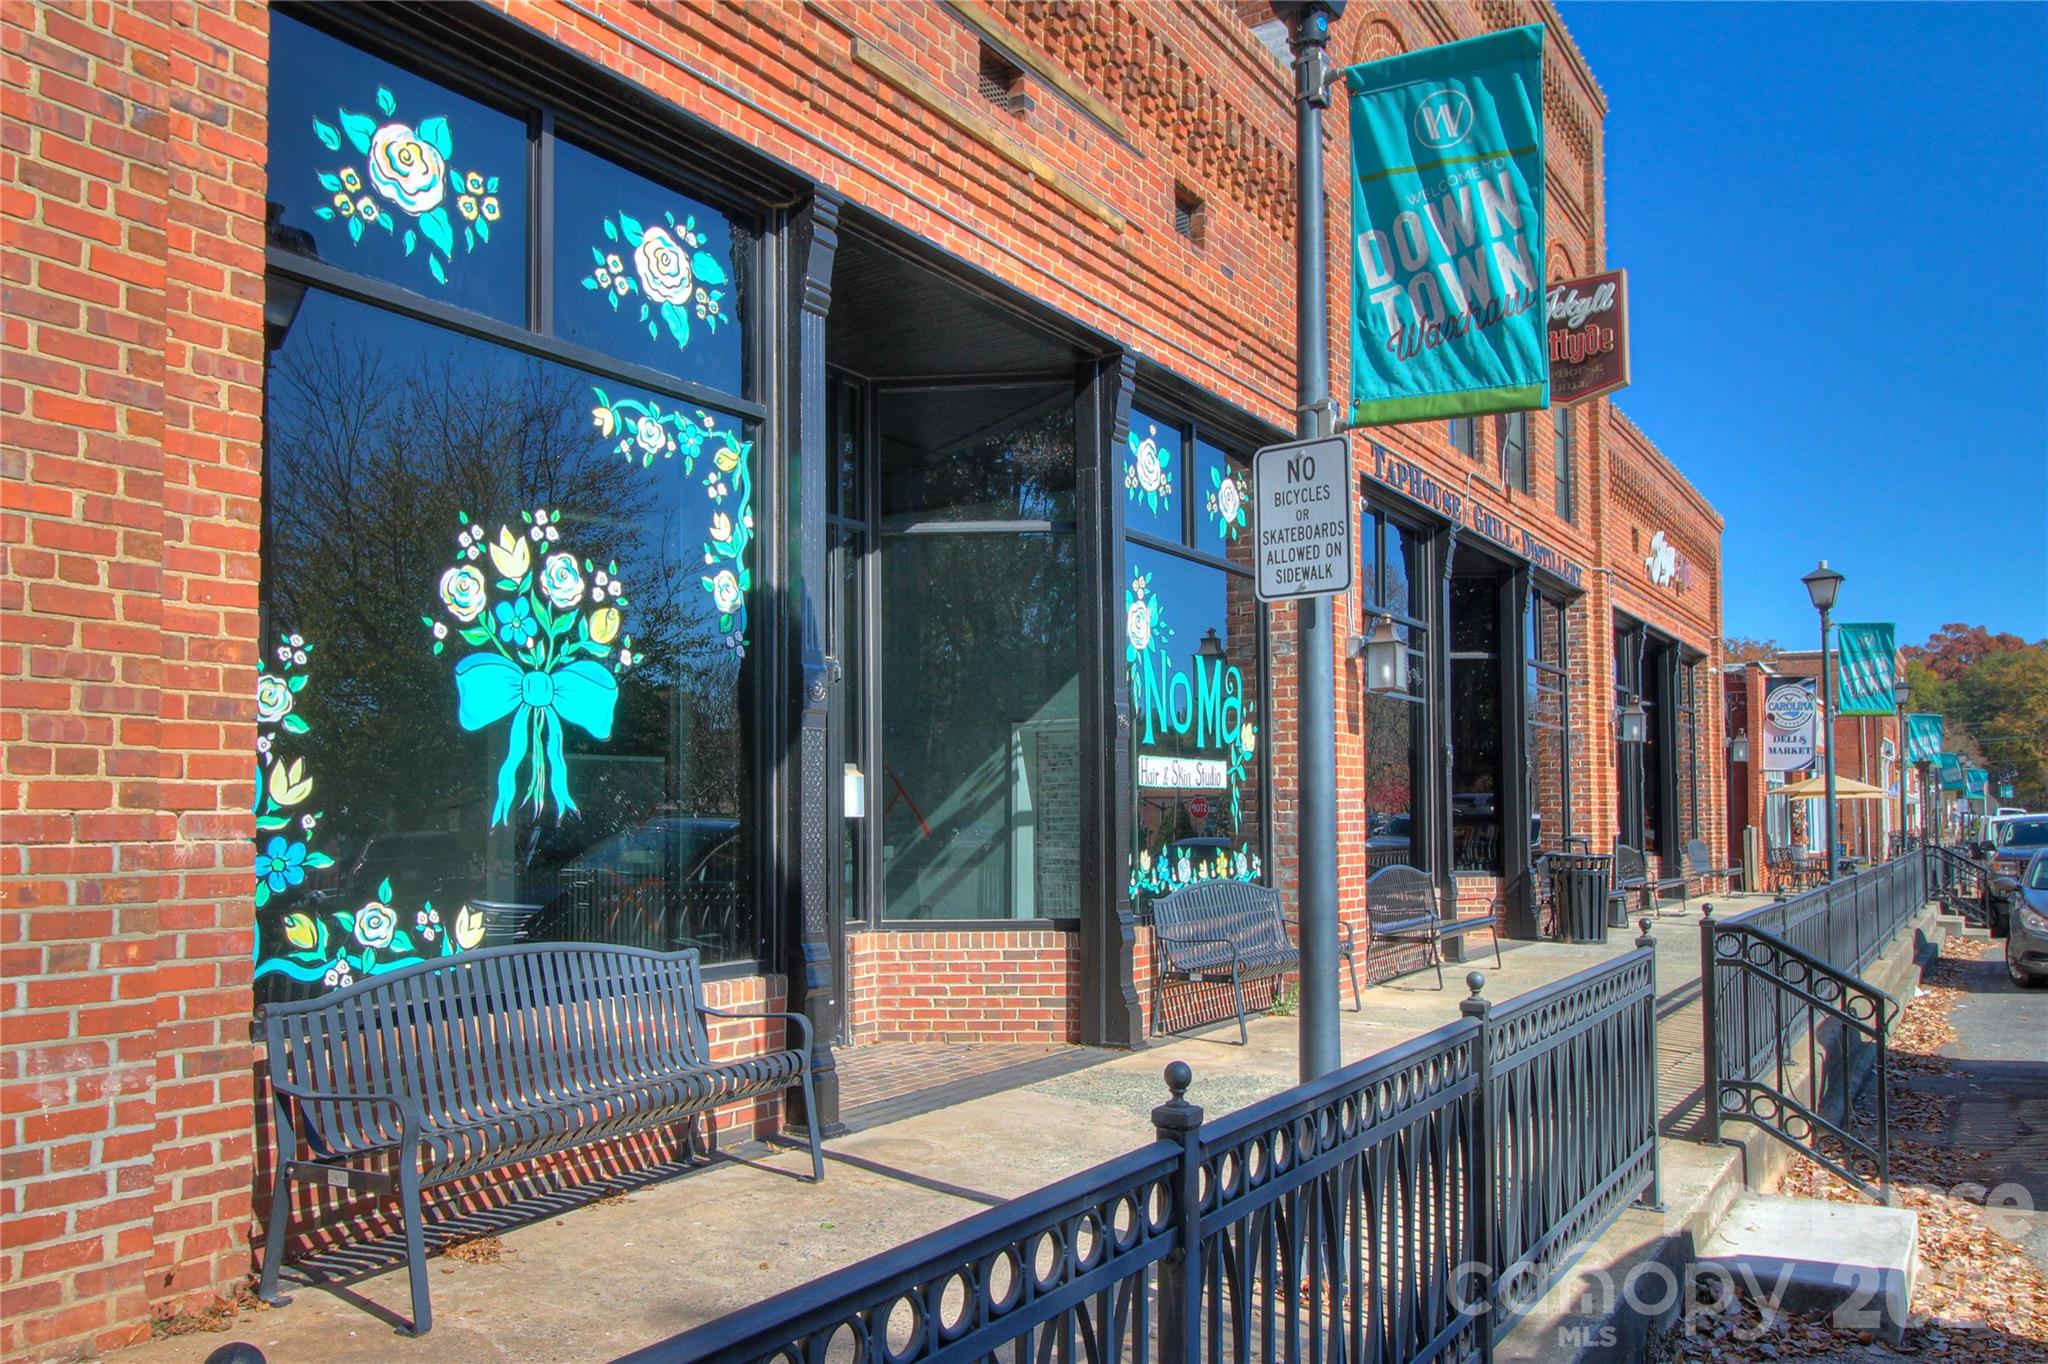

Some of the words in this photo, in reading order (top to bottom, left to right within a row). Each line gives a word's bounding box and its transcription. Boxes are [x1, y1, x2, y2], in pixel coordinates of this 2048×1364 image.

[1405, 167, 1482, 206] WELCOME
[1484, 157, 1506, 174] TO
[1358, 171, 1524, 290] DOWN
[1370, 233, 1538, 337] TOWN
[1546, 281, 1616, 328] Jekyll
[1385, 288, 1538, 363] Waxhaw
[1550, 323, 1614, 364] Hyde
[1287, 456, 1316, 484] NO
[1274, 484, 1331, 507] BICYCLES
[1296, 508, 1310, 521] OR
[1262, 520, 1345, 546] SKATEBOARDS
[1266, 544, 1320, 565] ALLOWED
[1325, 541, 1342, 558] ON
[1275, 563, 1333, 585] SIDEWALK
[1768, 747, 1812, 755] MARKET
[1773, 735, 1798, 744] DELI
[1141, 756, 1159, 785] Hair
[1162, 766, 1169, 786] &
[1195, 761, 1221, 787] Studio
